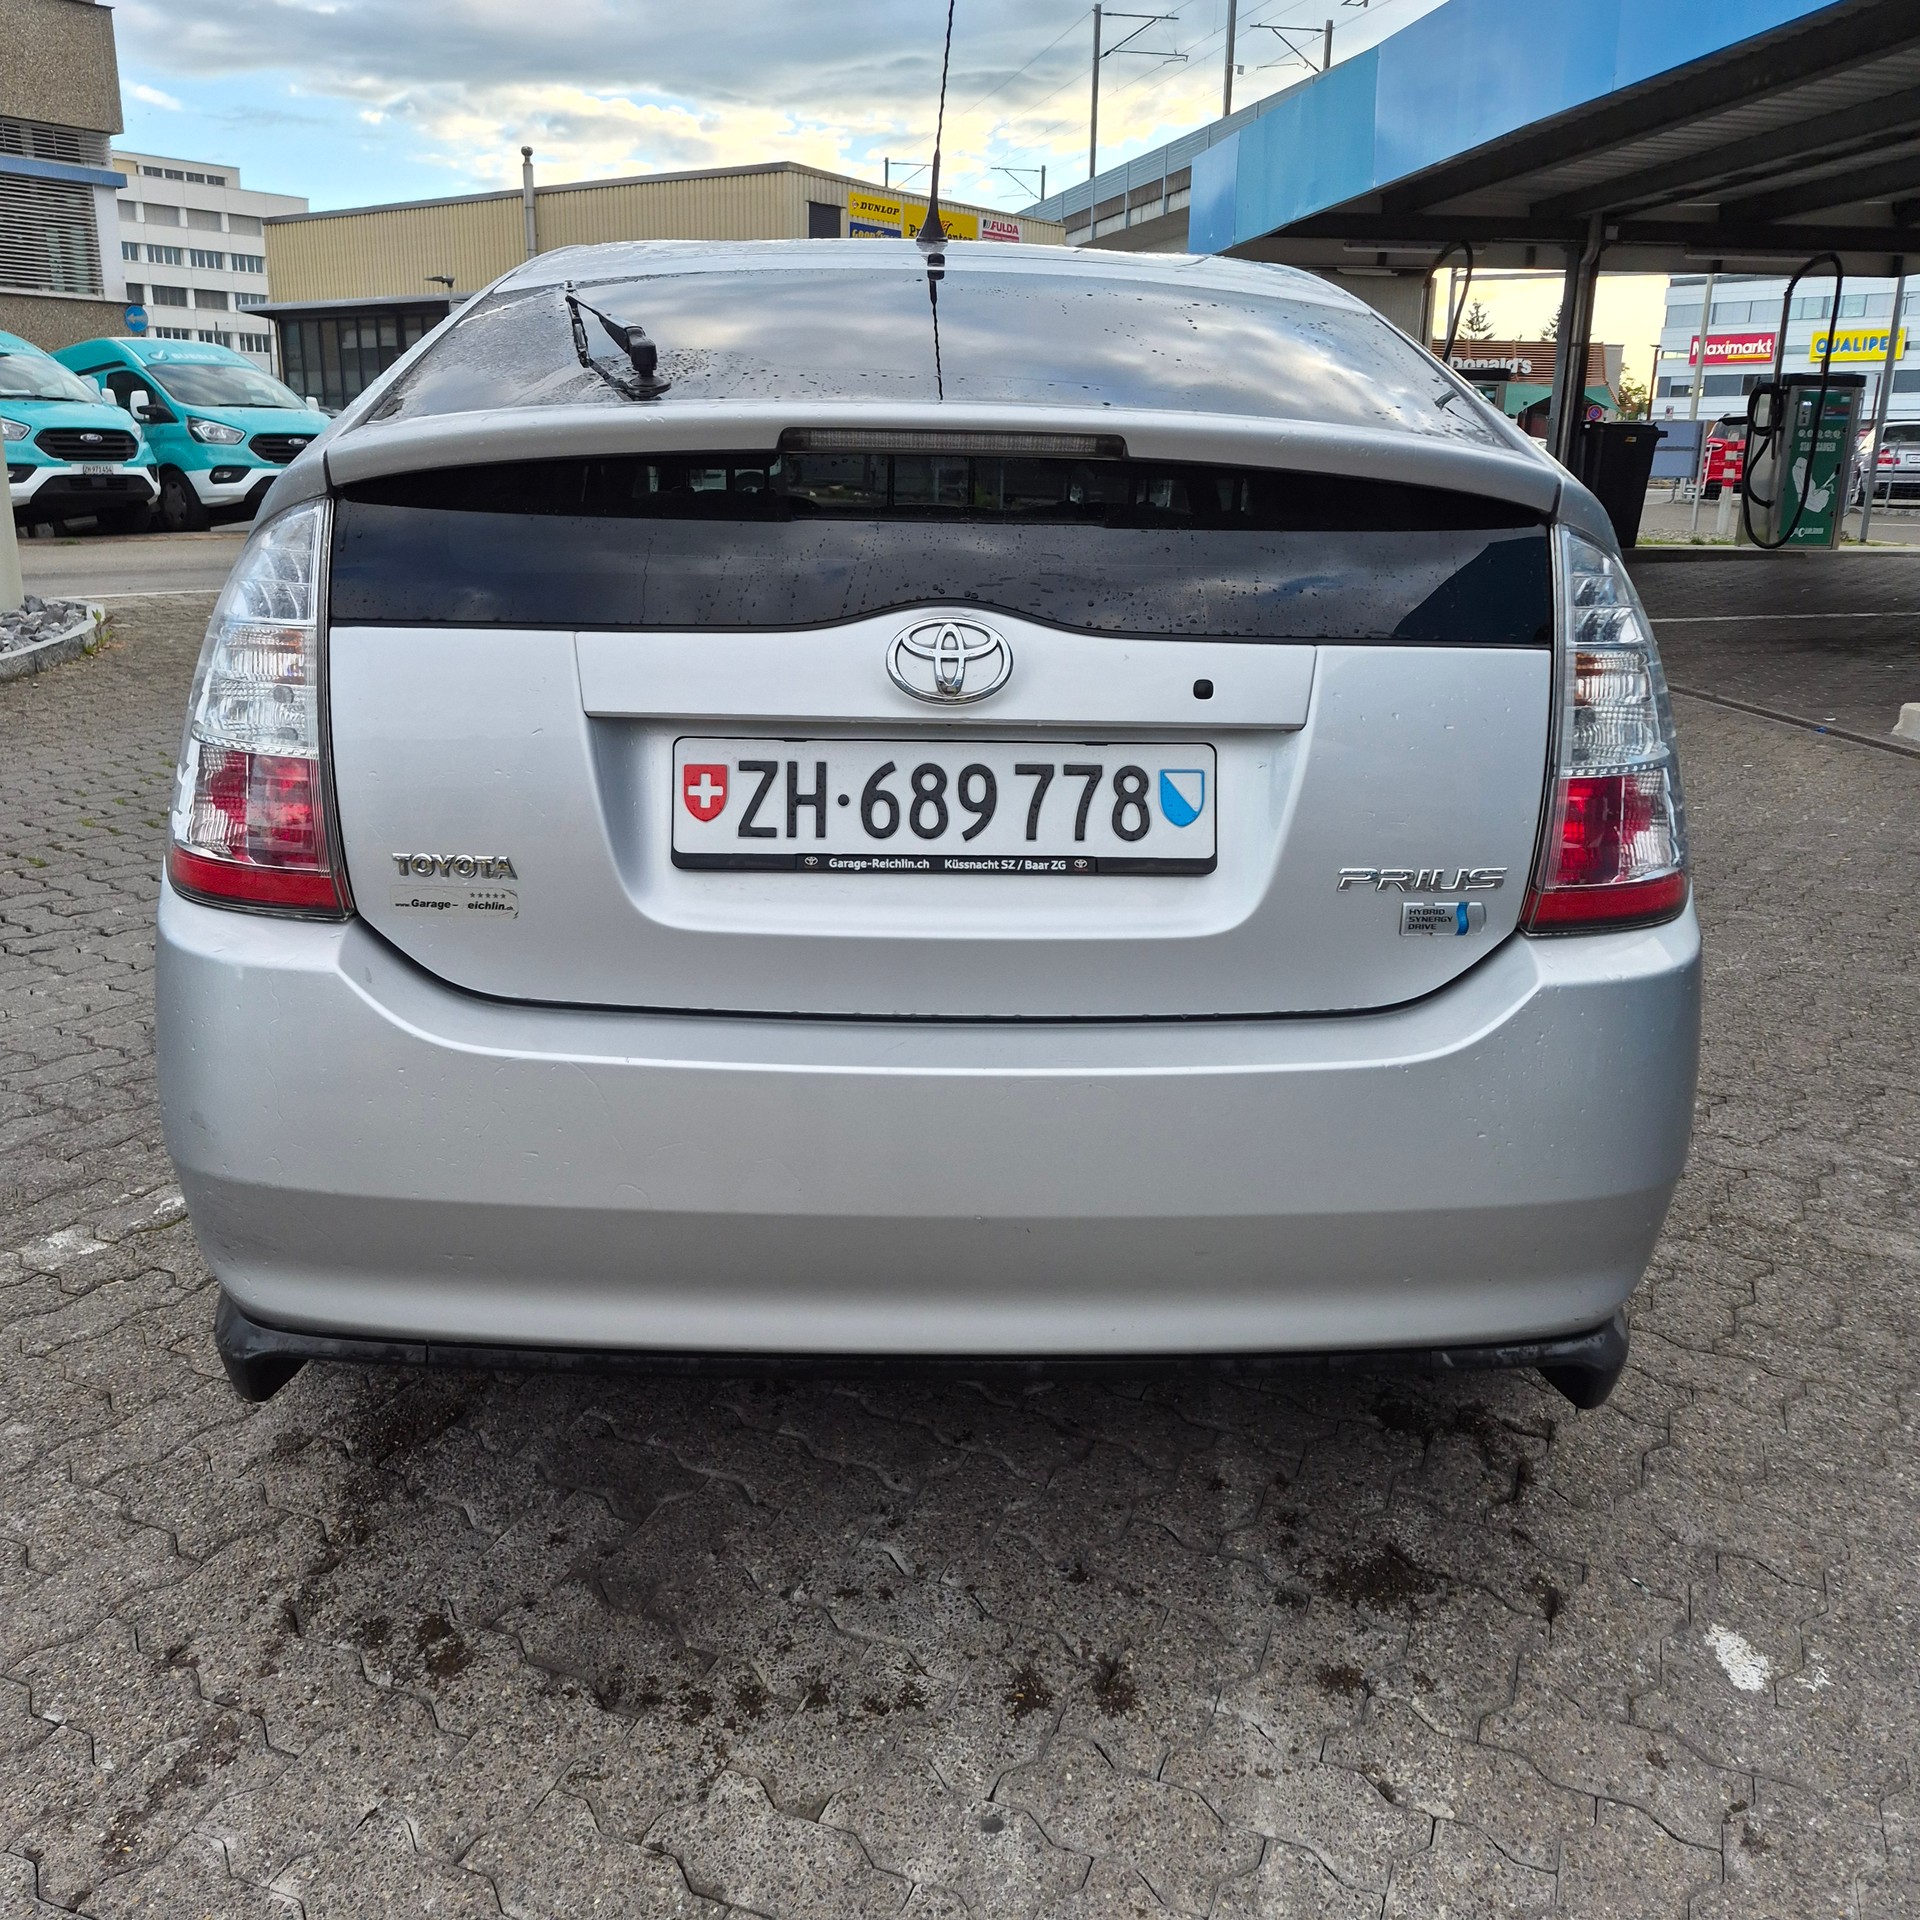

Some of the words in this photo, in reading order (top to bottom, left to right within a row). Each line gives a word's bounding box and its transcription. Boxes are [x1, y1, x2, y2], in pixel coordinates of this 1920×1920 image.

[860, 201, 900, 215] DUNLOP
[990, 221, 1019, 235] FULDA
[1692, 339, 1772, 356] Maximarkt
[1816, 334, 1900, 353] QUALIPE
[392, 853, 518, 880] TOYOTA
[829, 858, 930, 870] Garage-Reichlin.ch
[944, 859, 999, 870] Küssnacht
[1001, 860, 1015, 869] SZ
[1025, 860, 1049, 870] Baar
[1051, 860, 1066, 870] ZG
[1337, 867, 1507, 893] PRIUS
[1408, 915, 1453, 923] SYNERGY
[1409, 908, 1445, 916] HYBRID
